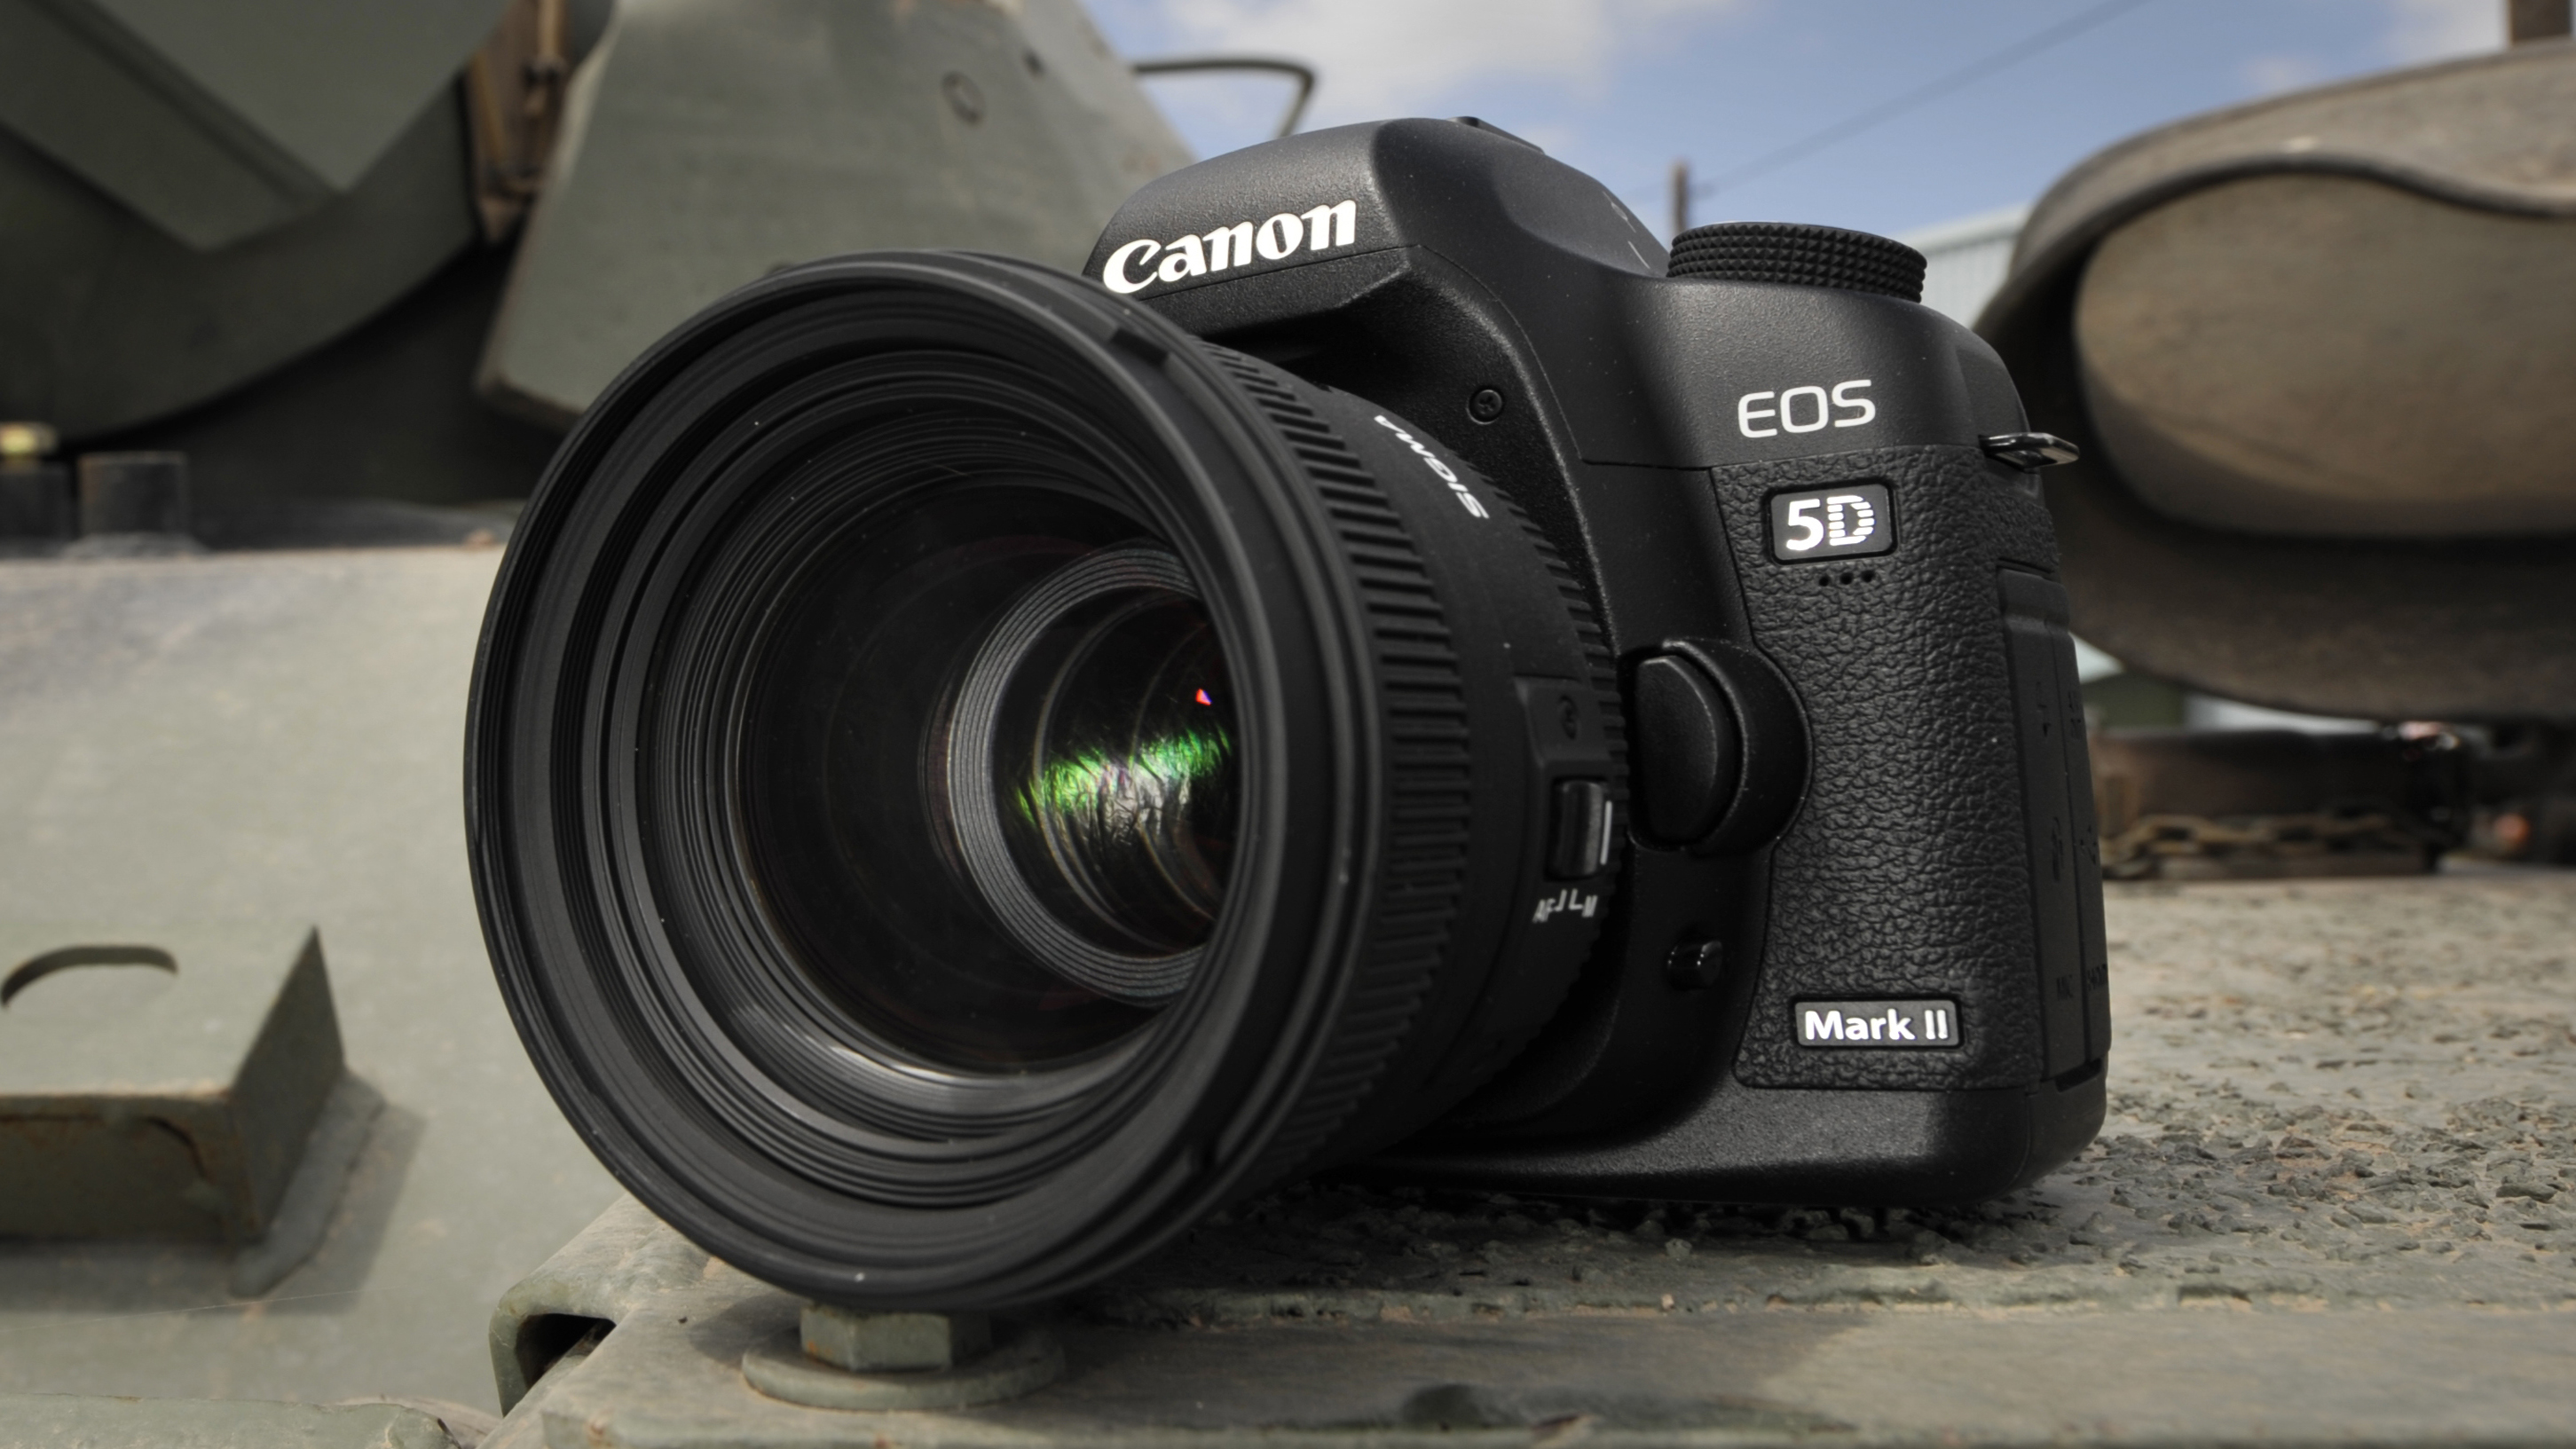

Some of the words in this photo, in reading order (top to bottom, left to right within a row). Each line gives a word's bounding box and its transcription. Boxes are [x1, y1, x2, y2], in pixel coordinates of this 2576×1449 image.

[1103, 200, 1357, 294] Canon
[1737, 379, 1876, 438] EOS
[1372, 412, 1491, 520] SIGMA
[1784, 494, 1875, 553] 5D
[1804, 1008, 1916, 1041] Mark
[1924, 1009, 1949, 1040] II
